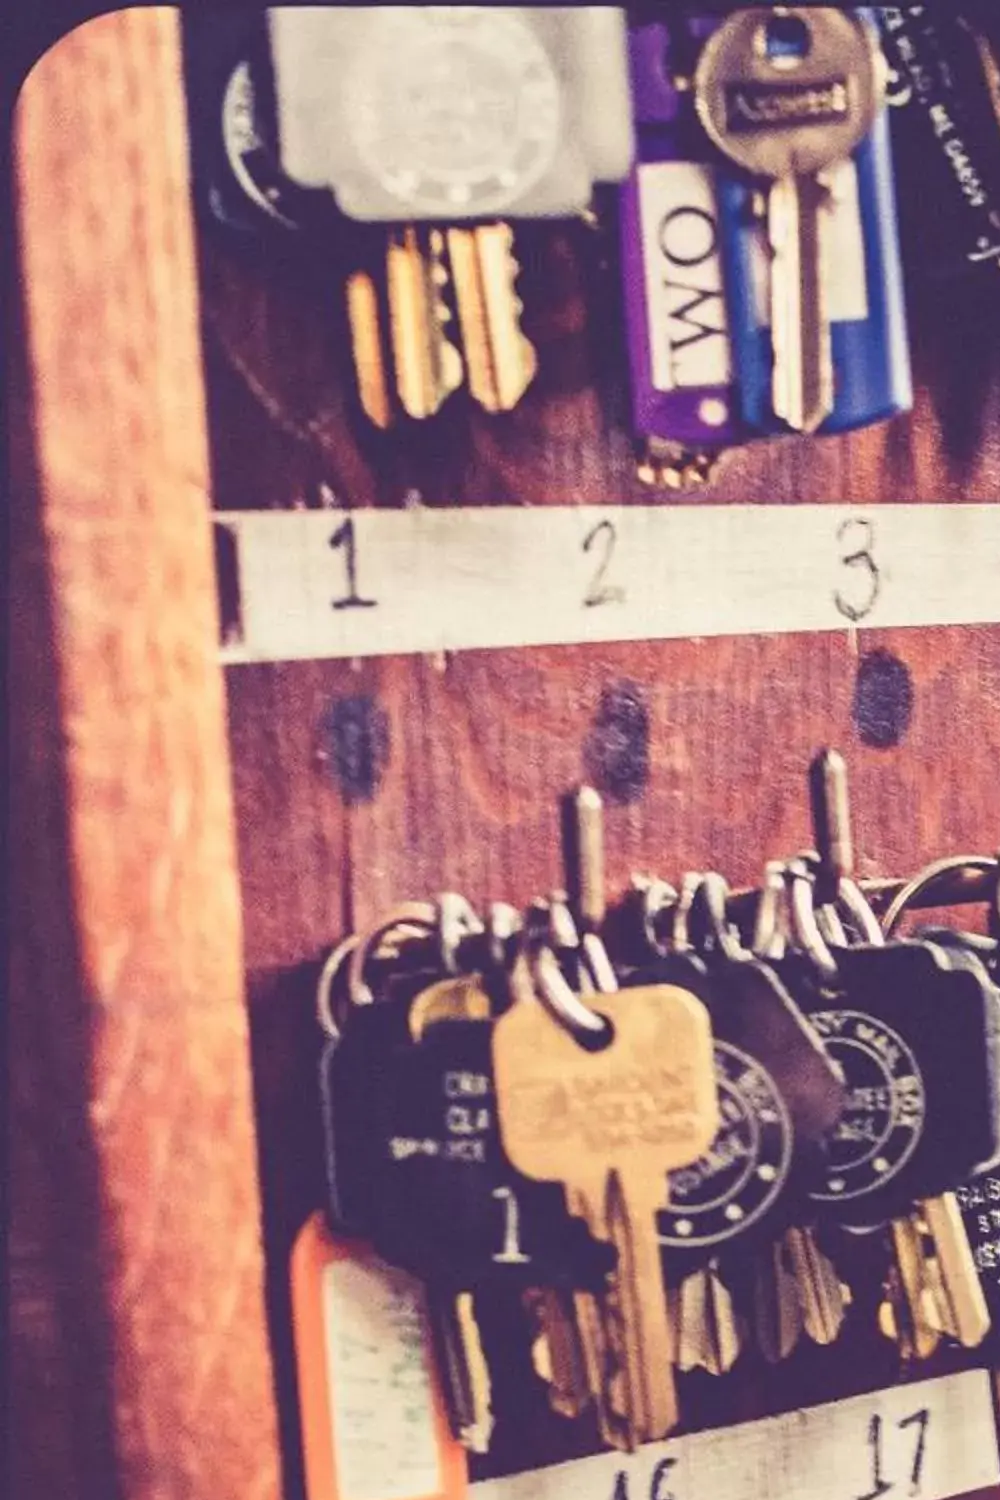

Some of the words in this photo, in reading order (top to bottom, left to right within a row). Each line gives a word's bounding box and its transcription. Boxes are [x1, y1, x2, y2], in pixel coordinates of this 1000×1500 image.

[328, 518, 377, 610] 1
[583, 521, 624, 608] 2
[834, 518, 878, 621] 3
[491, 1187, 531, 1263] 1
